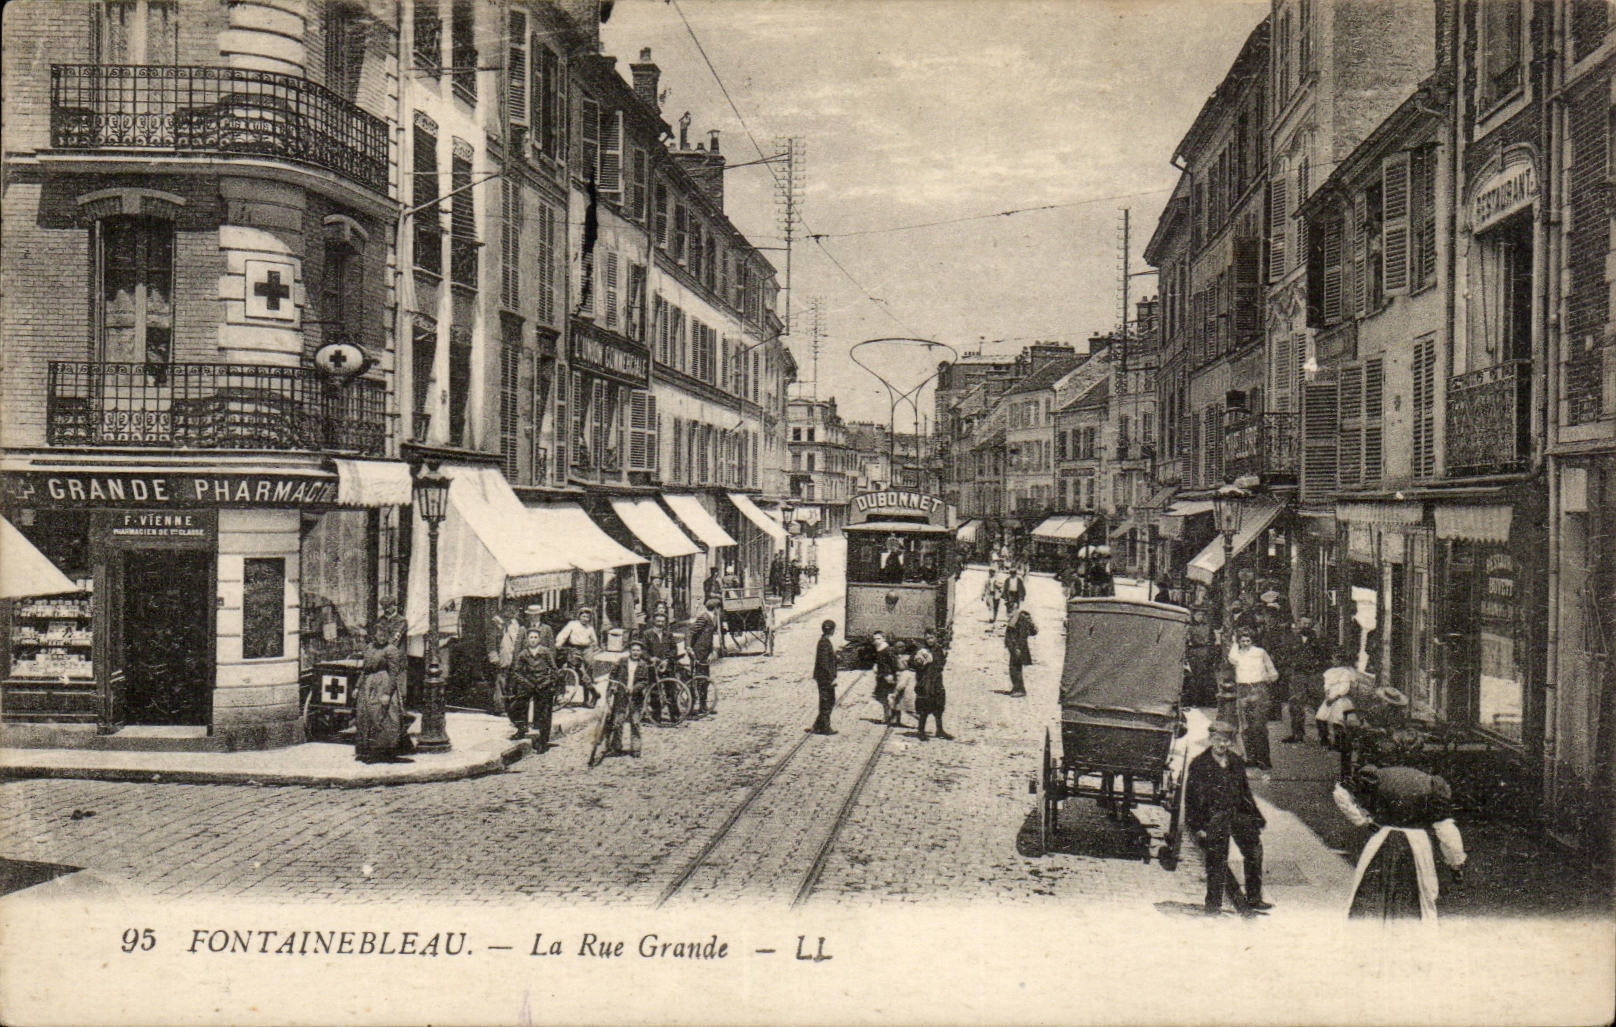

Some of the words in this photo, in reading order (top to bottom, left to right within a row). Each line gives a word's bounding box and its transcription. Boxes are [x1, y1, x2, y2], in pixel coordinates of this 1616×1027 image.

[47, 478, 169, 501] GRANDE
[856, 491, 943, 513] DUBONNET
[140, 515, 193, 526] VIENNE
[113, 528, 157, 536] PHARMACIEN
[158, 528, 169, 536] DE
